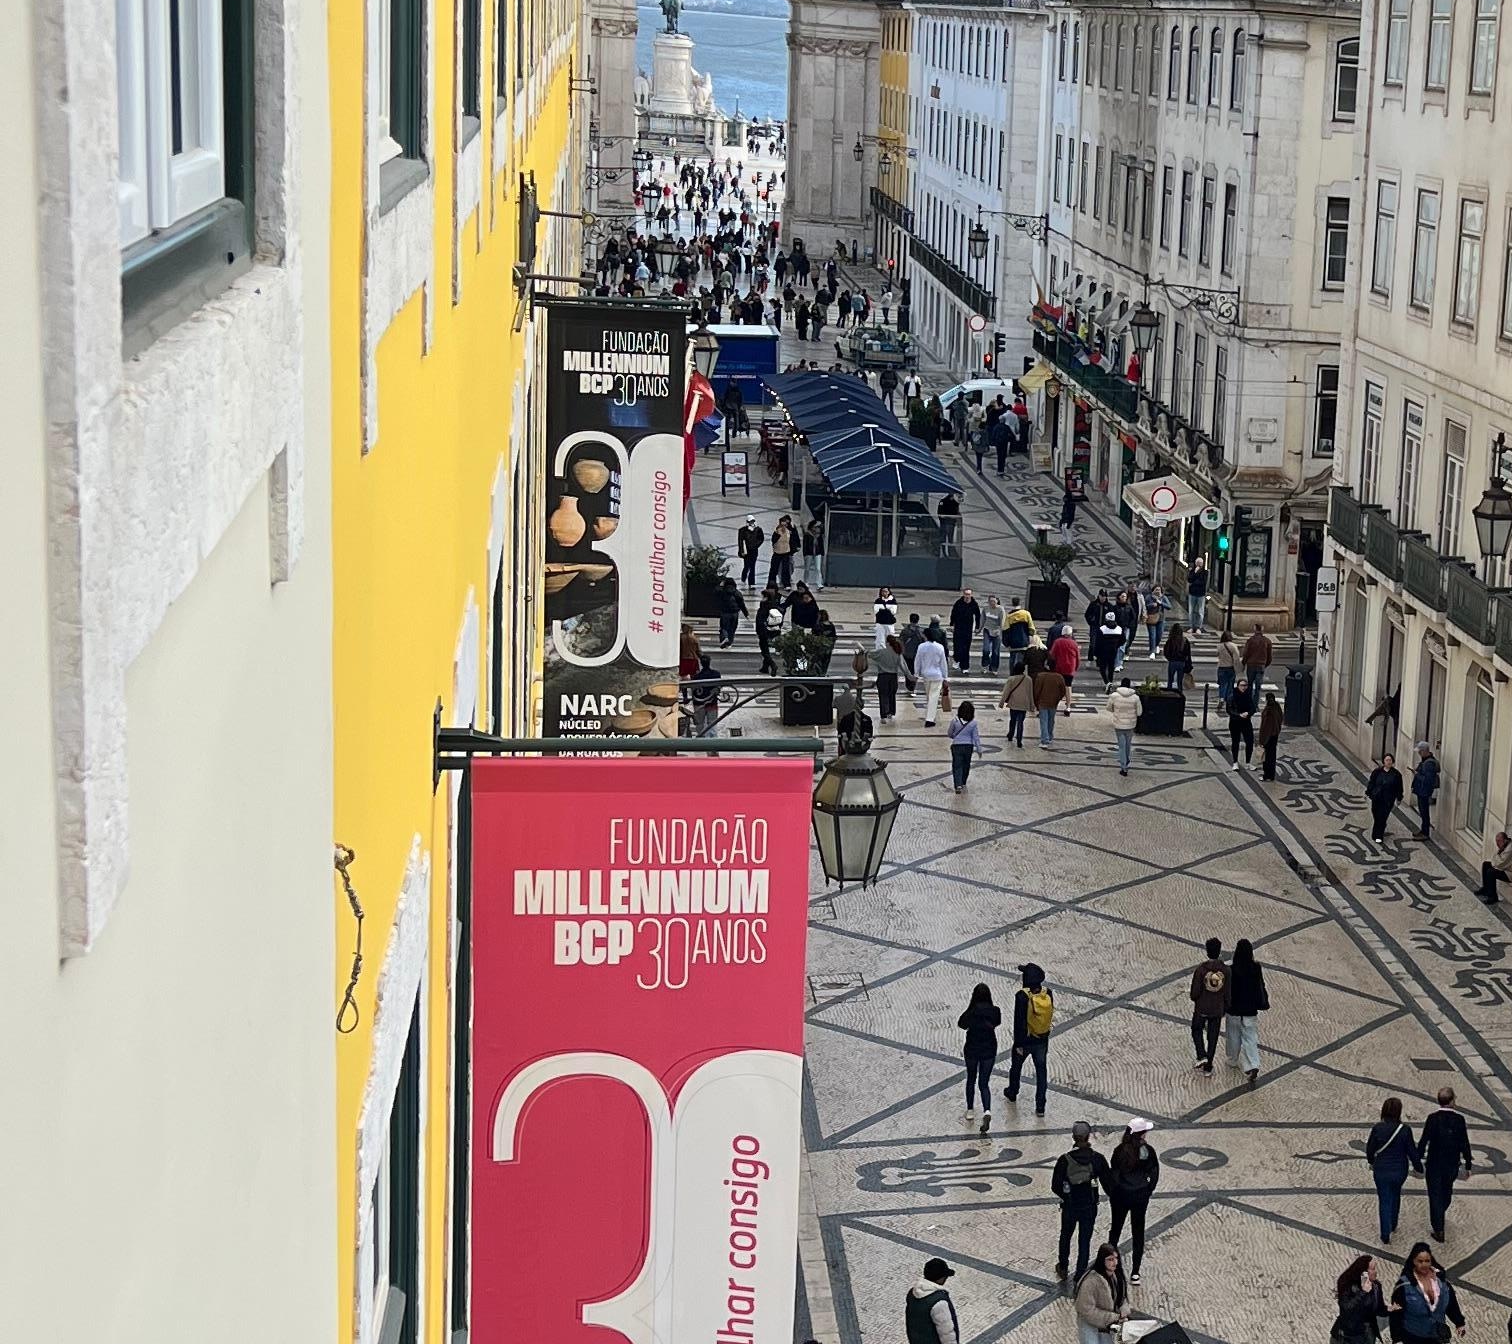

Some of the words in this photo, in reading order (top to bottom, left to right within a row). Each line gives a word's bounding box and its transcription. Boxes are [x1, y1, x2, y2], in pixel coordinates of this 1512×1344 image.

[563, 350, 670, 375] MILLENNIUM
[602, 330, 669, 354] FUNDAÇÃO
[580, 373, 613, 394] BCP
[614, 374, 637, 406] 30
[637, 376, 669, 397] ANOS
[648, 470, 671, 531] consigo
[649, 537, 668, 605] partilhar
[559, 717, 601, 730] NÚCLEO
[560, 694, 633, 716] NARC
[609, 813, 768, 867] FUNDAÇÃO
[513, 869, 770, 916] MILLENNIUM
[554, 920, 634, 965] BCP
[636, 917, 690, 989] 30
[692, 918, 767, 964] ANOS
[723, 1134, 770, 1269] consigo
